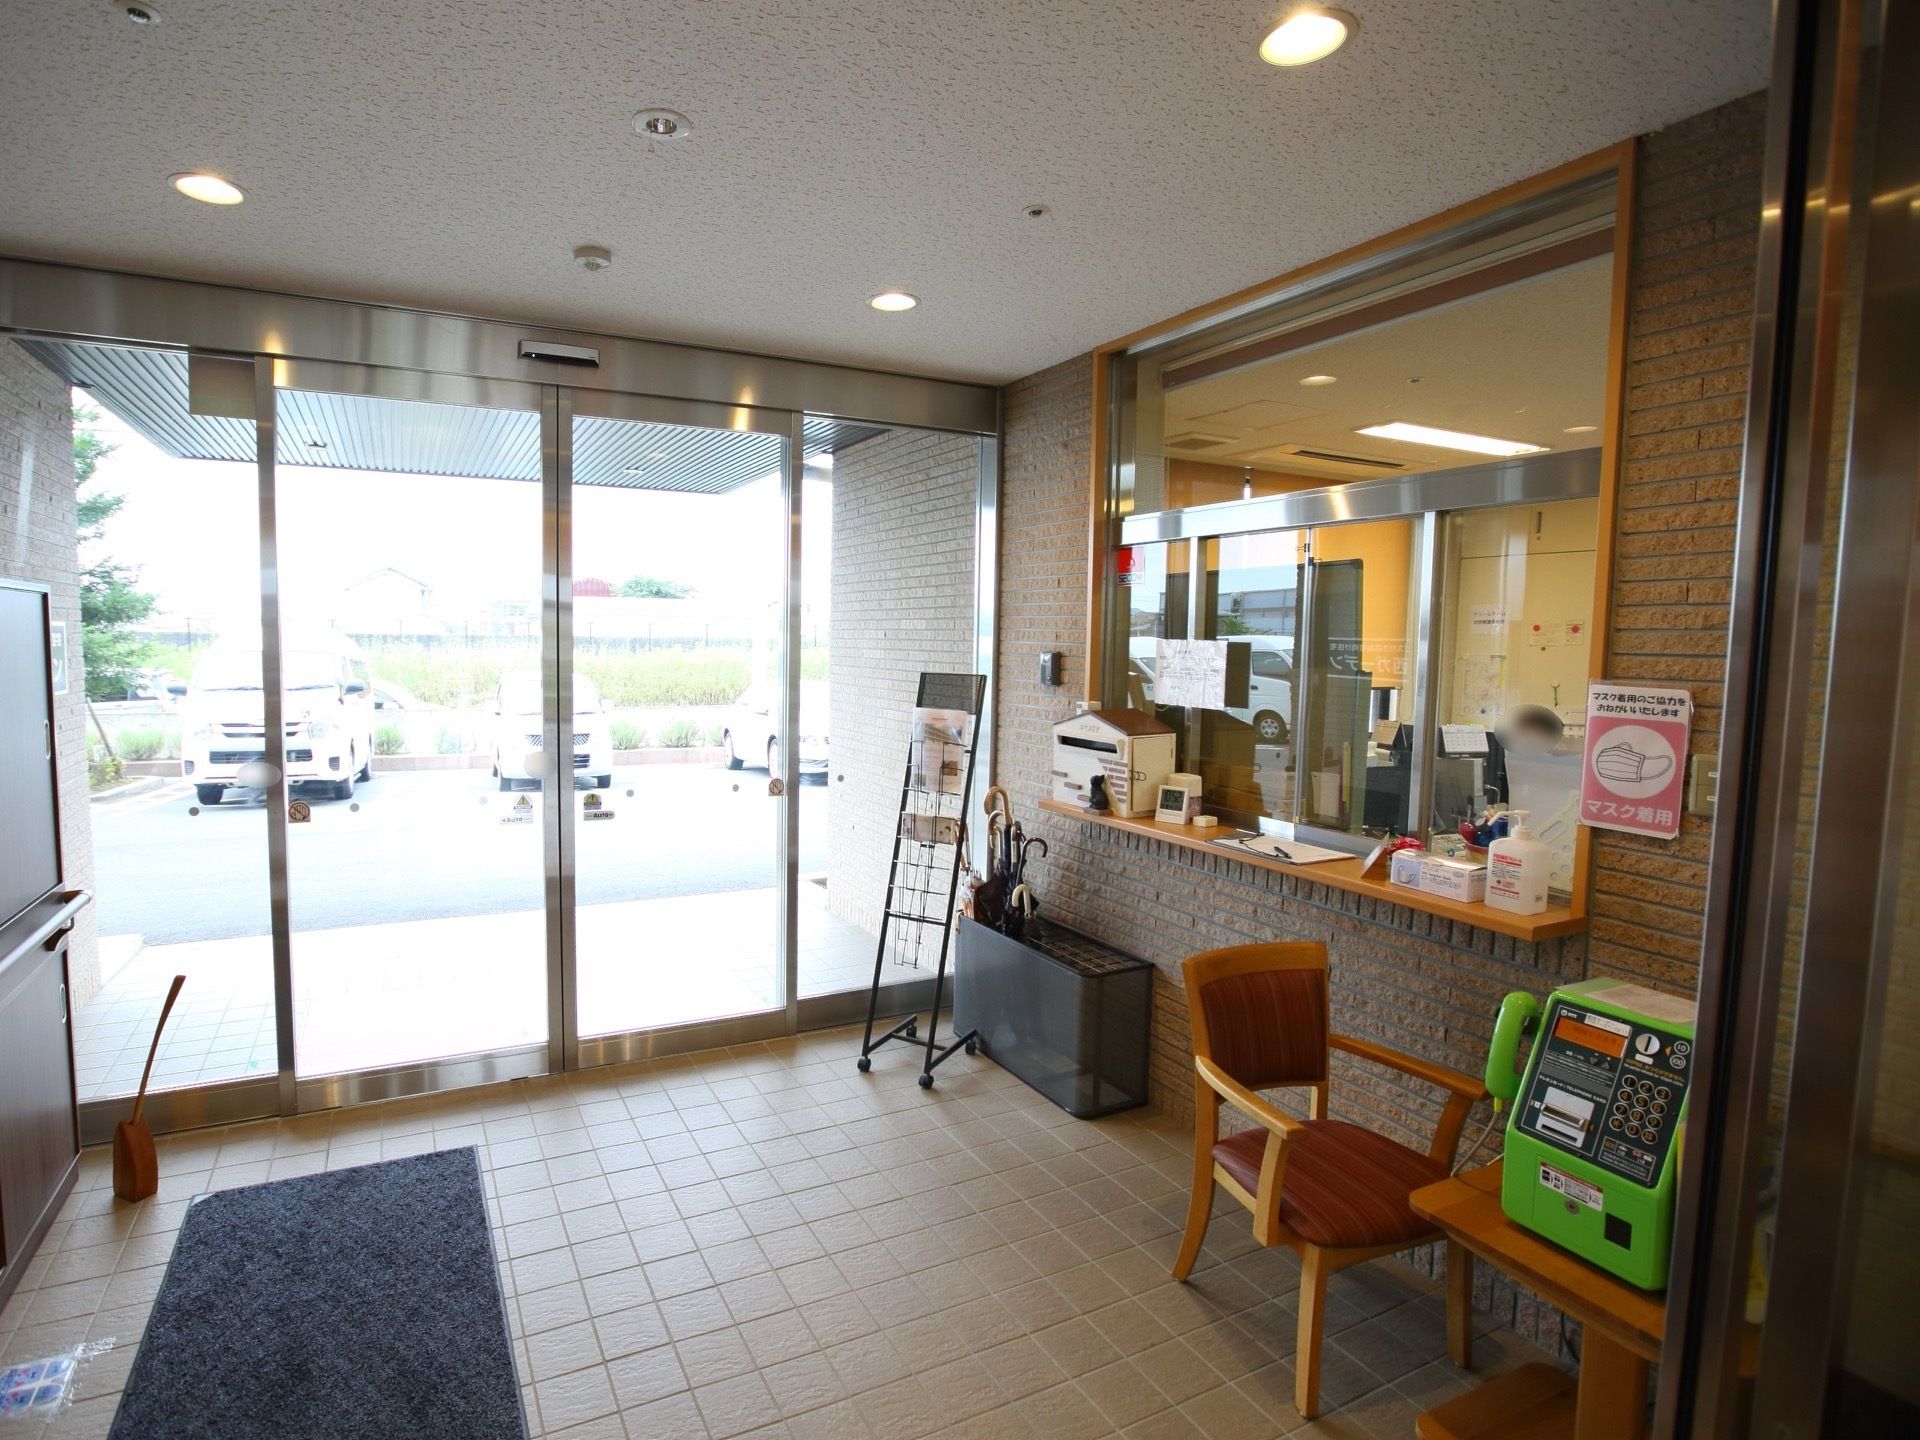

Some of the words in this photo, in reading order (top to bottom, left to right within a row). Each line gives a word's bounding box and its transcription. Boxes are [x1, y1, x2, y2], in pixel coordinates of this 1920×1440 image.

[1592, 692, 1687, 707] マスク着用のご協力を
[1597, 704, 1680, 717] おねがいいたします
[1587, 800, 1673, 826] マスク着用
[1671, 1058, 1684, 1067] 100
